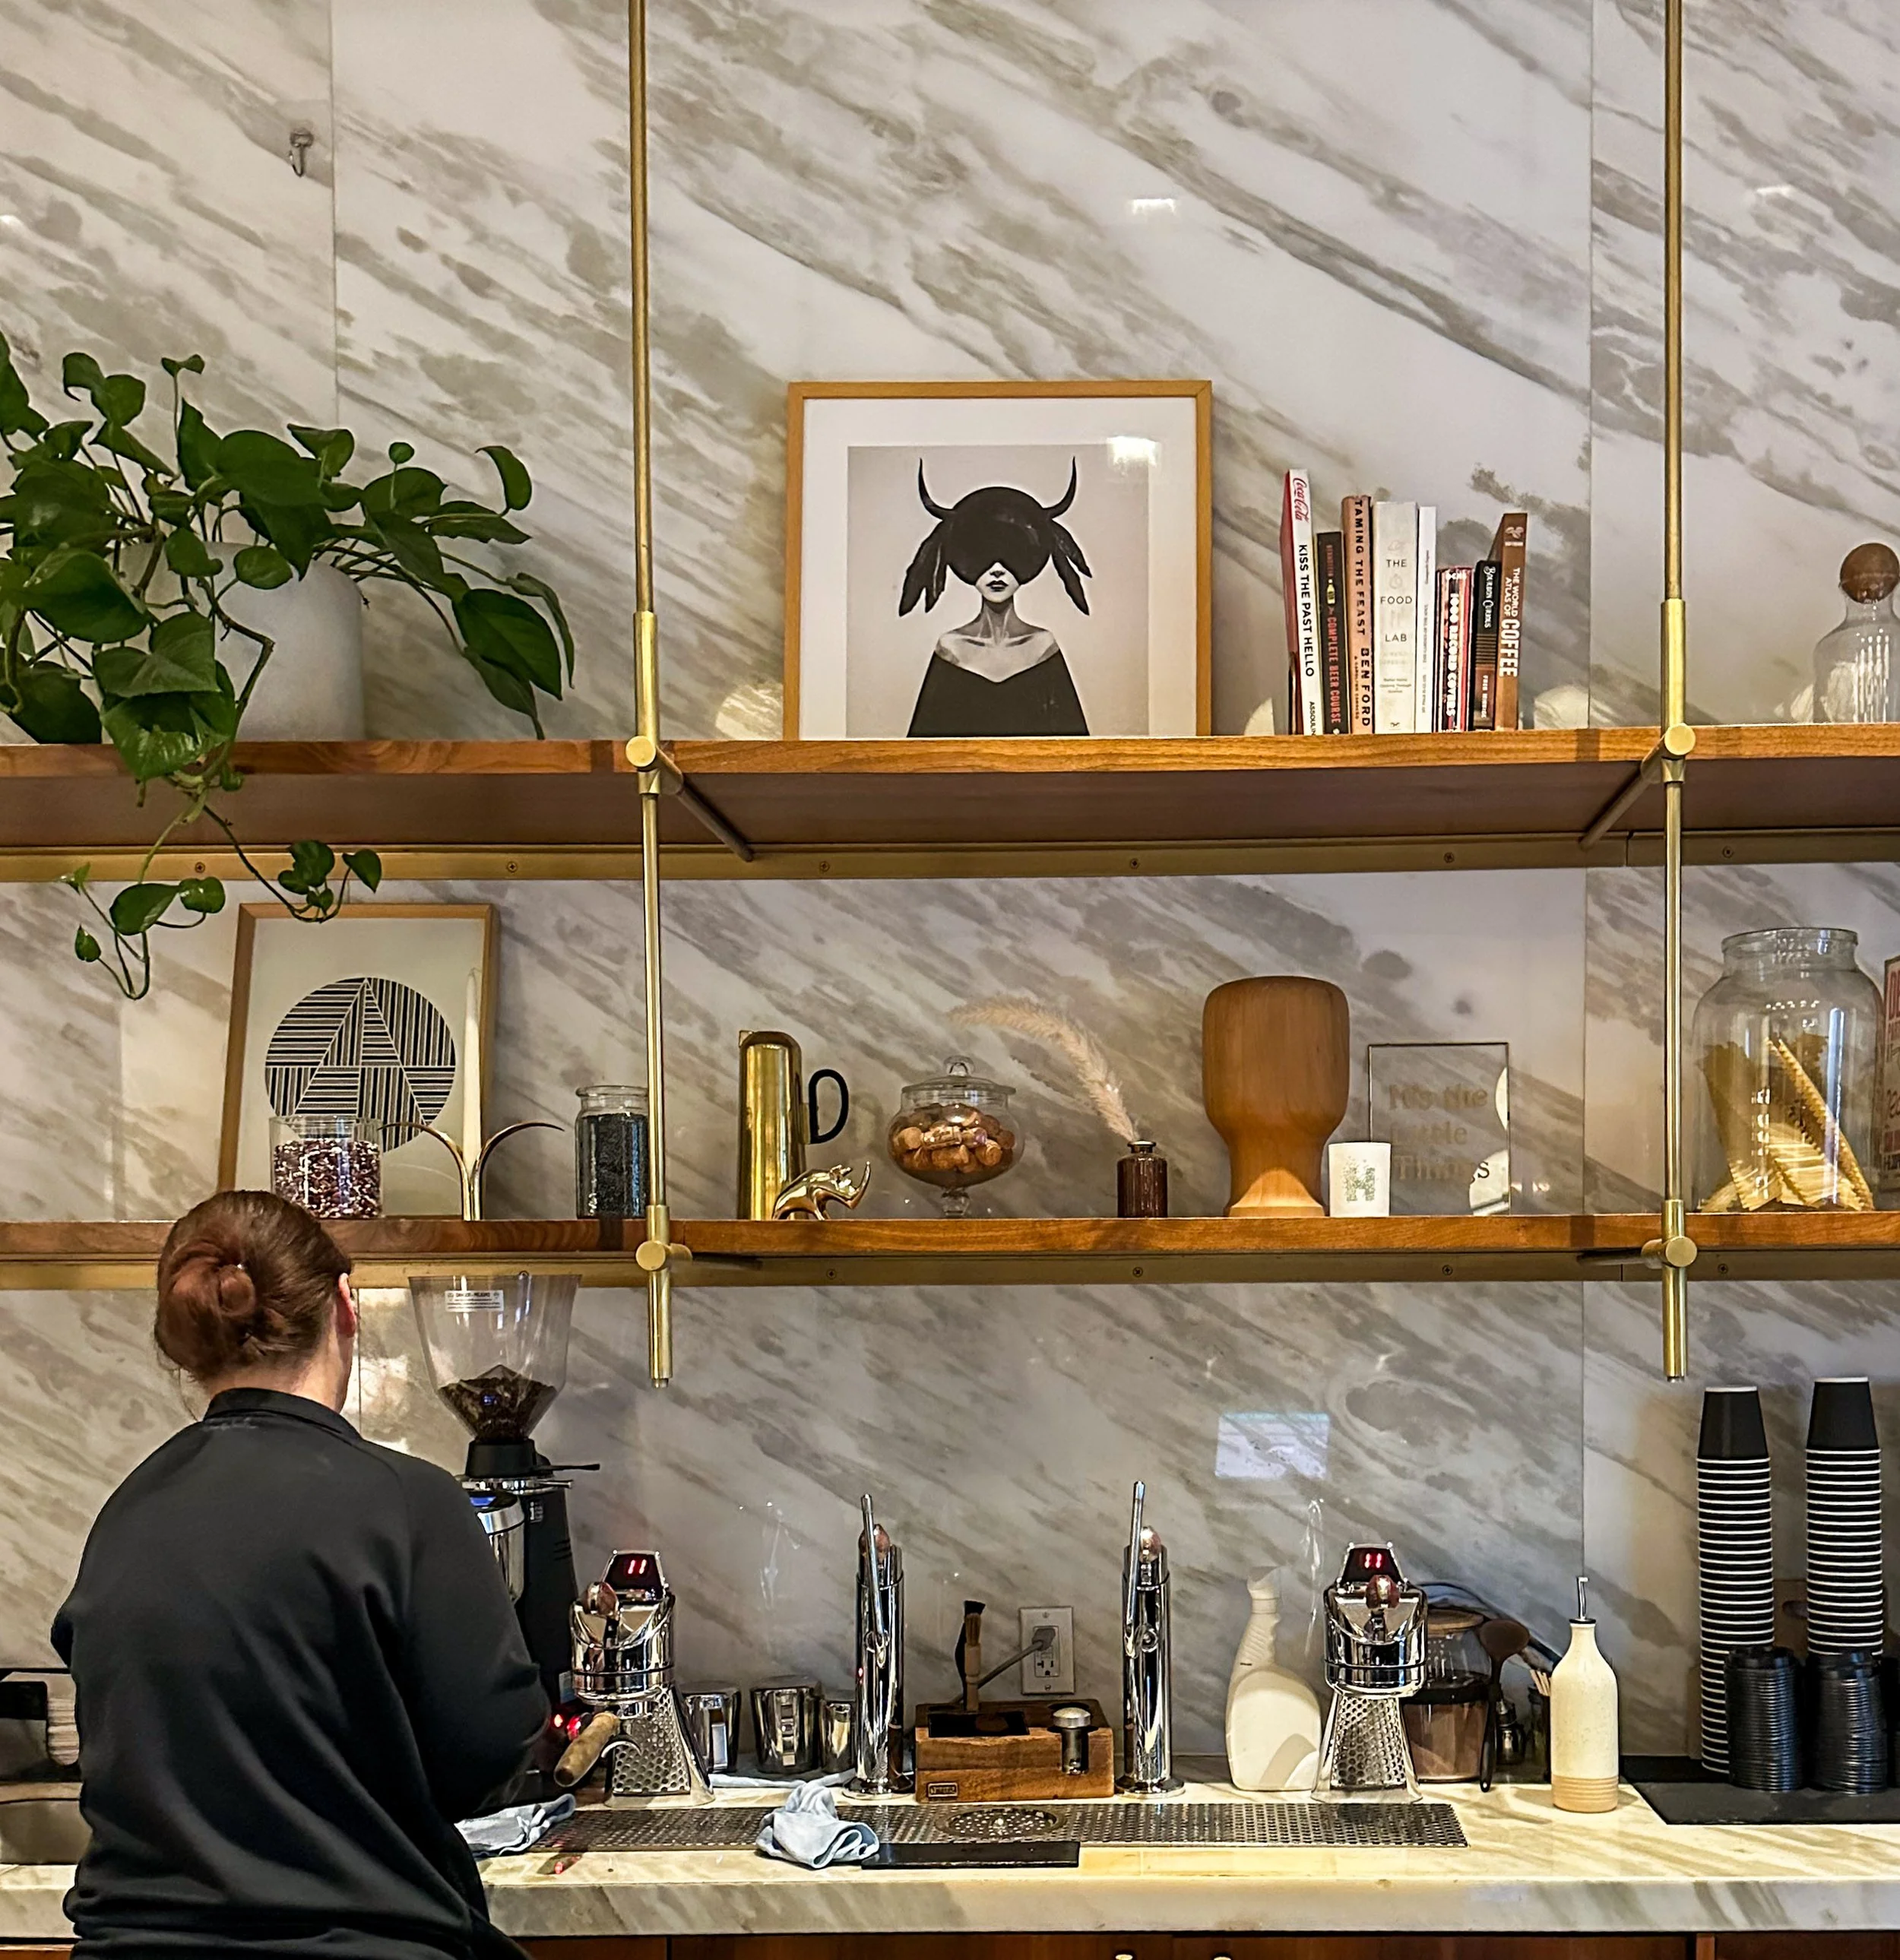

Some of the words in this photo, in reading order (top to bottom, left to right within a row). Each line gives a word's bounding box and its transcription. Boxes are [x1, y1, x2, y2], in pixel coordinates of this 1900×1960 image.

[1354, 499, 1364, 554] TAMING
[1299, 544, 1309, 572] KISS
[1355, 559, 1364, 587] THE
[1386, 559, 1408, 568] THE
[1300, 575, 1310, 599] THE
[1504, 577, 1512, 603] ATLAS
[1512, 567, 1521, 584] THE
[1356, 592, 1366, 636] FEAST
[1380, 596, 1413, 605] FOOD
[1449, 593, 1459, 623] 1000
[1503, 604, 1511, 617] OF
[1511, 584, 1520, 617] WORLD
[1302, 603, 1313, 633] PAST
[1327, 616, 1338, 663] COMPLETE
[1385, 633, 1408, 642] LAB
[1447, 625, 1459, 671] RECORD
[1499, 619, 1521, 677] COFFEE
[1303, 637, 1315, 677] HELLO
[1360, 648, 1370, 680] BEN
[1328, 665, 1339, 688] BEER
[1330, 690, 1341, 724] COURSE
[1361, 685, 1371, 727] FORD
[1446, 673, 1458, 717] COVERS
